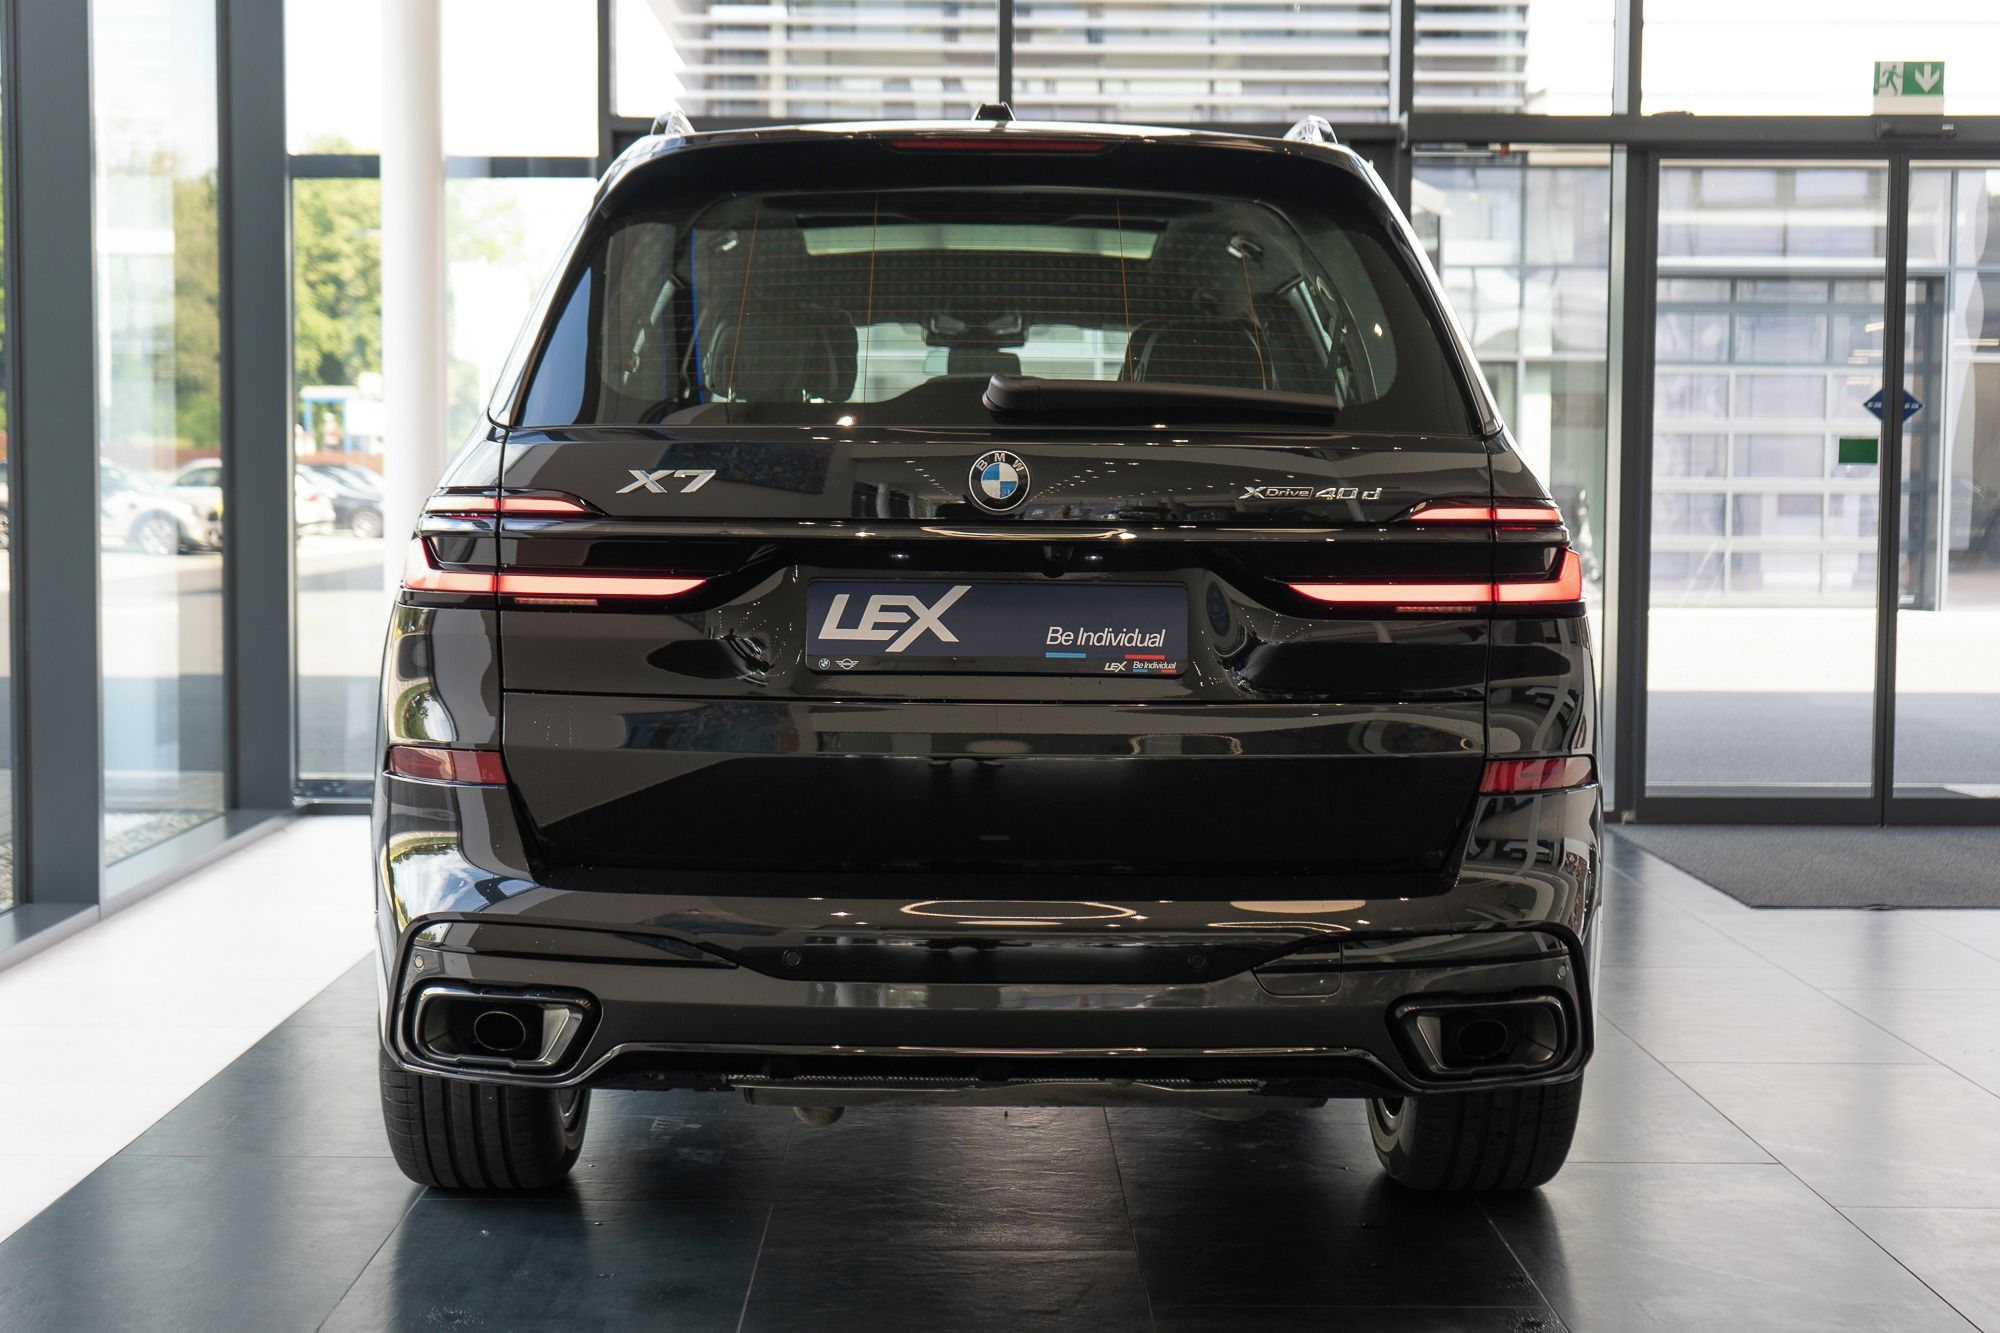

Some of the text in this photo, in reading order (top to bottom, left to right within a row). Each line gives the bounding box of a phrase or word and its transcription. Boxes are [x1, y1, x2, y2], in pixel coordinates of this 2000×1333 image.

[976, 453, 1024, 471] BMW
[616, 470, 717, 493] X7
[818, 586, 972, 653] LEX
[1046, 626, 1165, 647] Be Individual
[1104, 661, 1176, 672] LEX Be Individual
